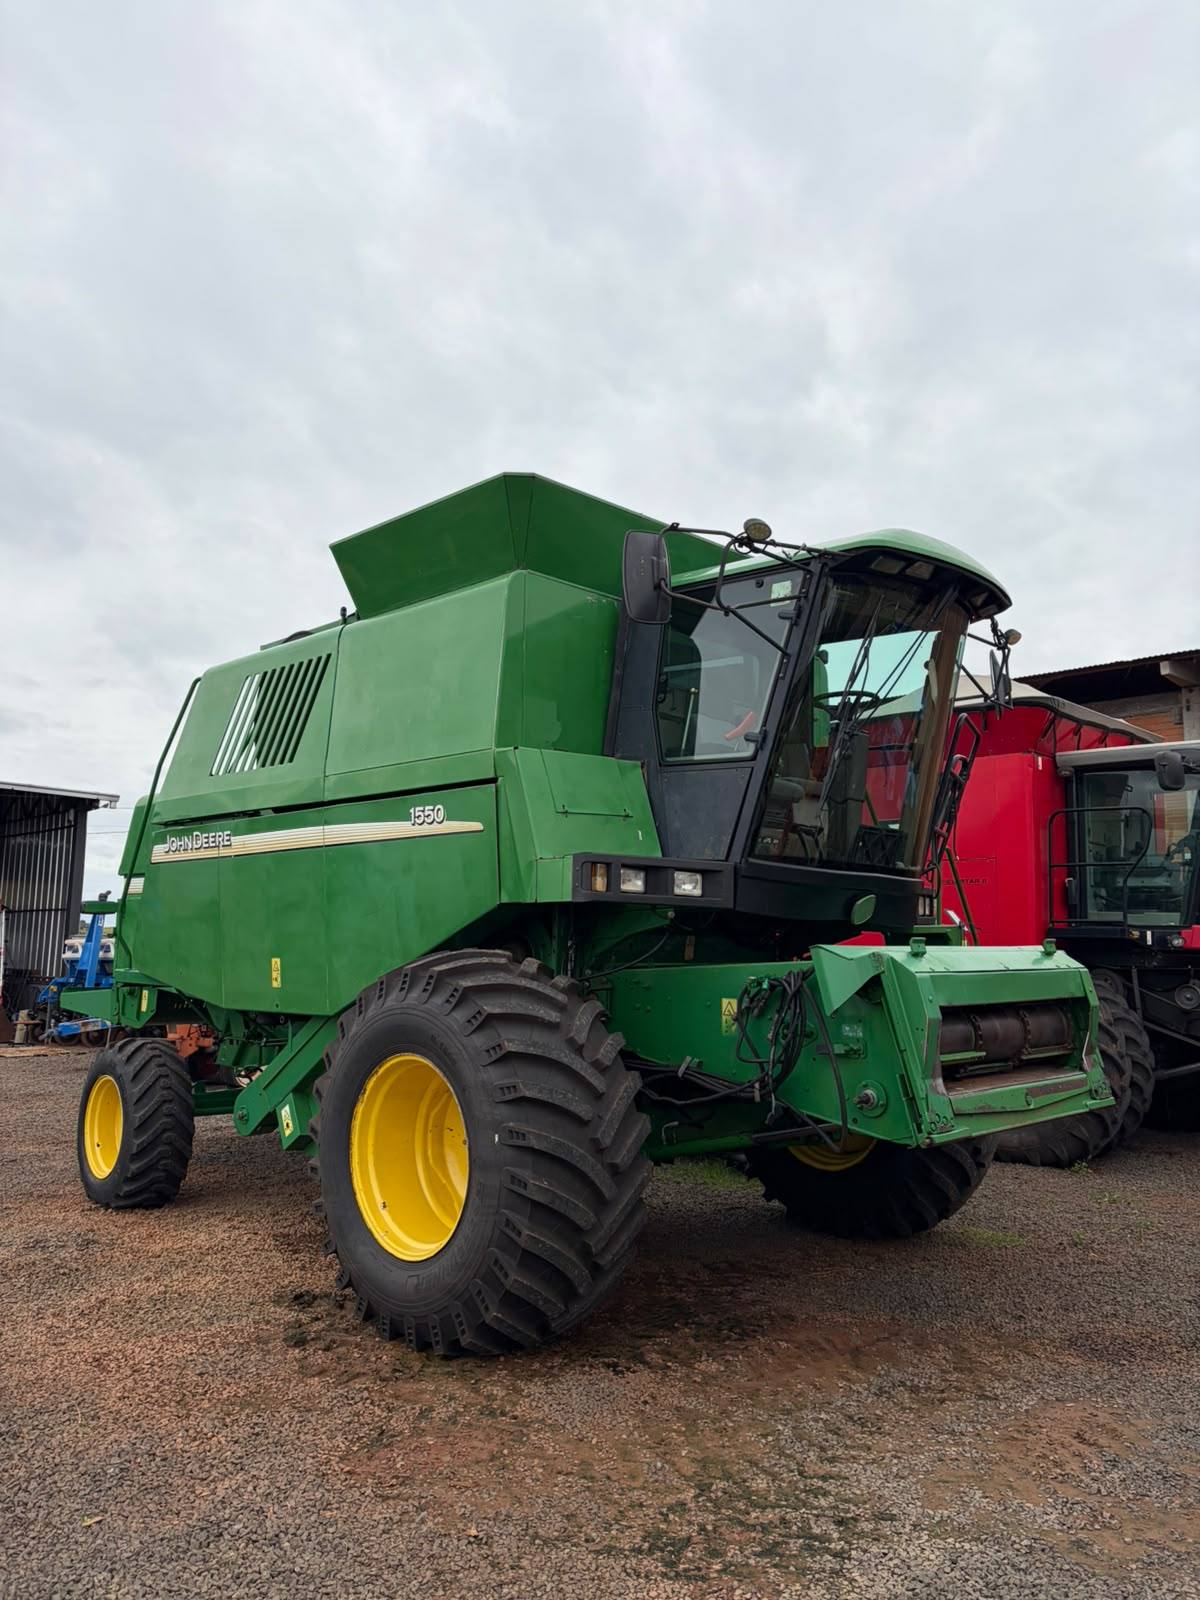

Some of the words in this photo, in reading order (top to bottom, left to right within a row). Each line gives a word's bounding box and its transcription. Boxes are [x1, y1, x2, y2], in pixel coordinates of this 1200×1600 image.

[409, 804, 445, 826] 1550
[164, 834, 193, 854] JOHN
[193, 831, 232, 850] DEERE
